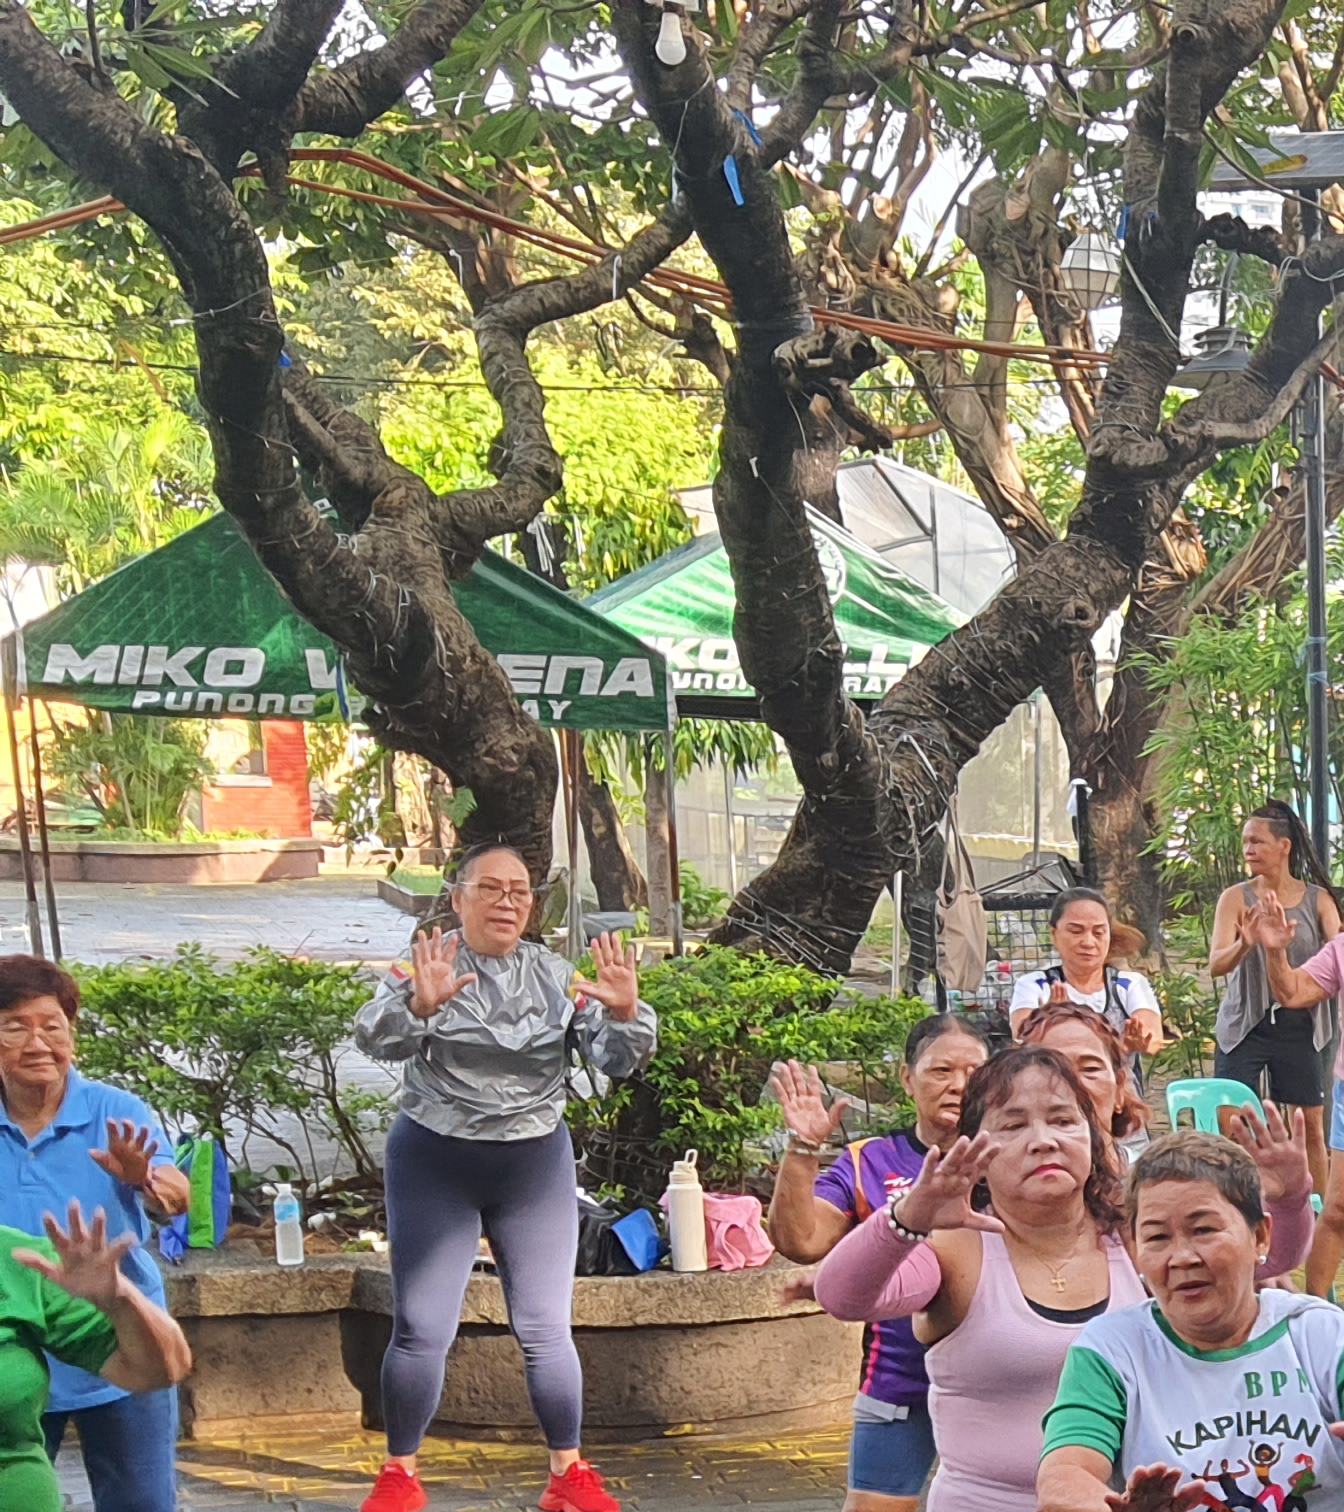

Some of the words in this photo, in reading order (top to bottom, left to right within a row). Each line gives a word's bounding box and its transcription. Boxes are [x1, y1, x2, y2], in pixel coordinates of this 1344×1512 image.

[43, 643, 266, 688] MIKO
[641, 636, 742, 669] KO
[131, 690, 317, 715] PUNONG
[1166, 1410, 1322, 1456] KAPIHAN
